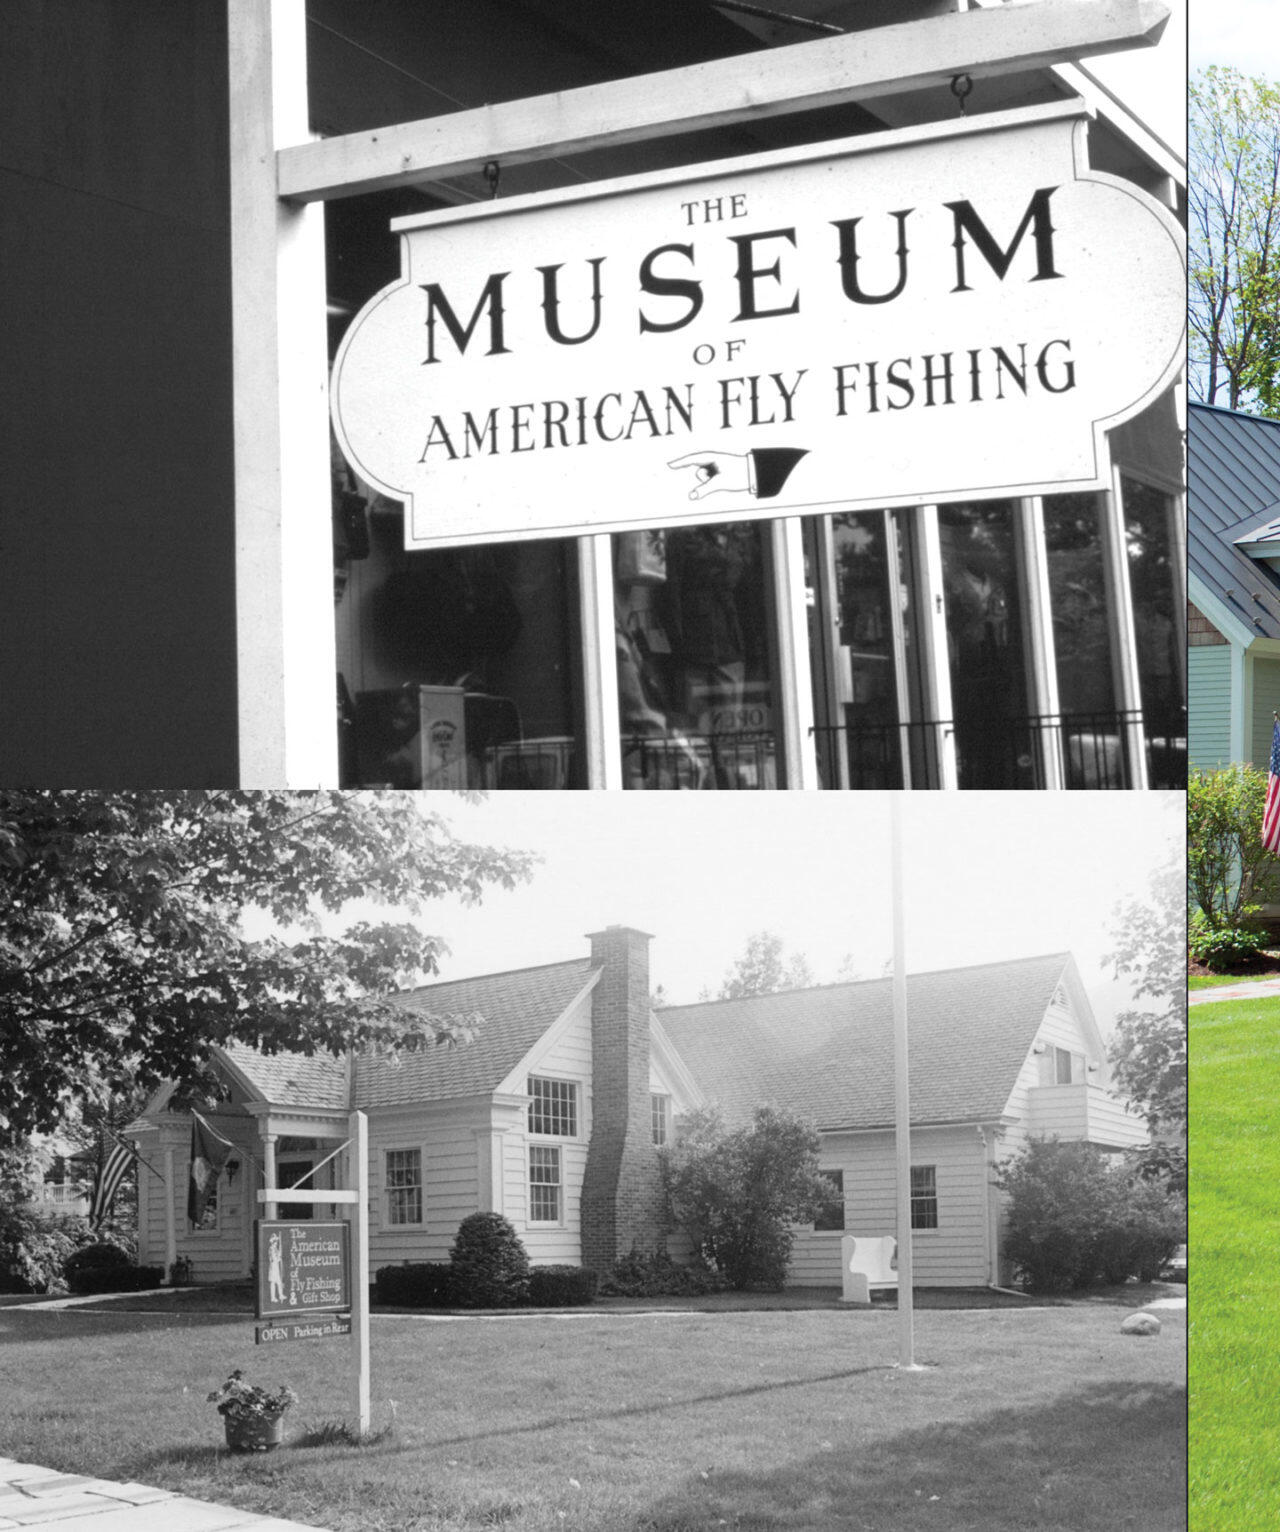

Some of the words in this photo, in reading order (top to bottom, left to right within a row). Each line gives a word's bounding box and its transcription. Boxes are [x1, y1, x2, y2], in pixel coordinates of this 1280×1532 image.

[680, 194, 748, 226] THE
[418, 186, 1067, 365] MUSEUM
[692, 339, 747, 365] OF
[418, 383, 695, 464] AMERICAN
[717, 369, 809, 429] FLY
[833, 339, 1077, 416] FISHING
[290, 1228, 306, 1239] The
[290, 1237, 340, 1252] American
[290, 1253, 341, 1267] Museum
[290, 1267, 299, 1278] of
[290, 1277, 306, 1293] Fly
[306, 1276, 341, 1292] Fishing
[289, 1292, 298, 1305] &
[302, 1292, 318, 1304] Gift
[320, 1291, 341, 1304] Shop
[261, 1327, 289, 1341] OPEN
[294, 1324, 323, 1338] Parking
[323, 1323, 332, 1334] in
[332, 1322, 349, 1333] Rear
